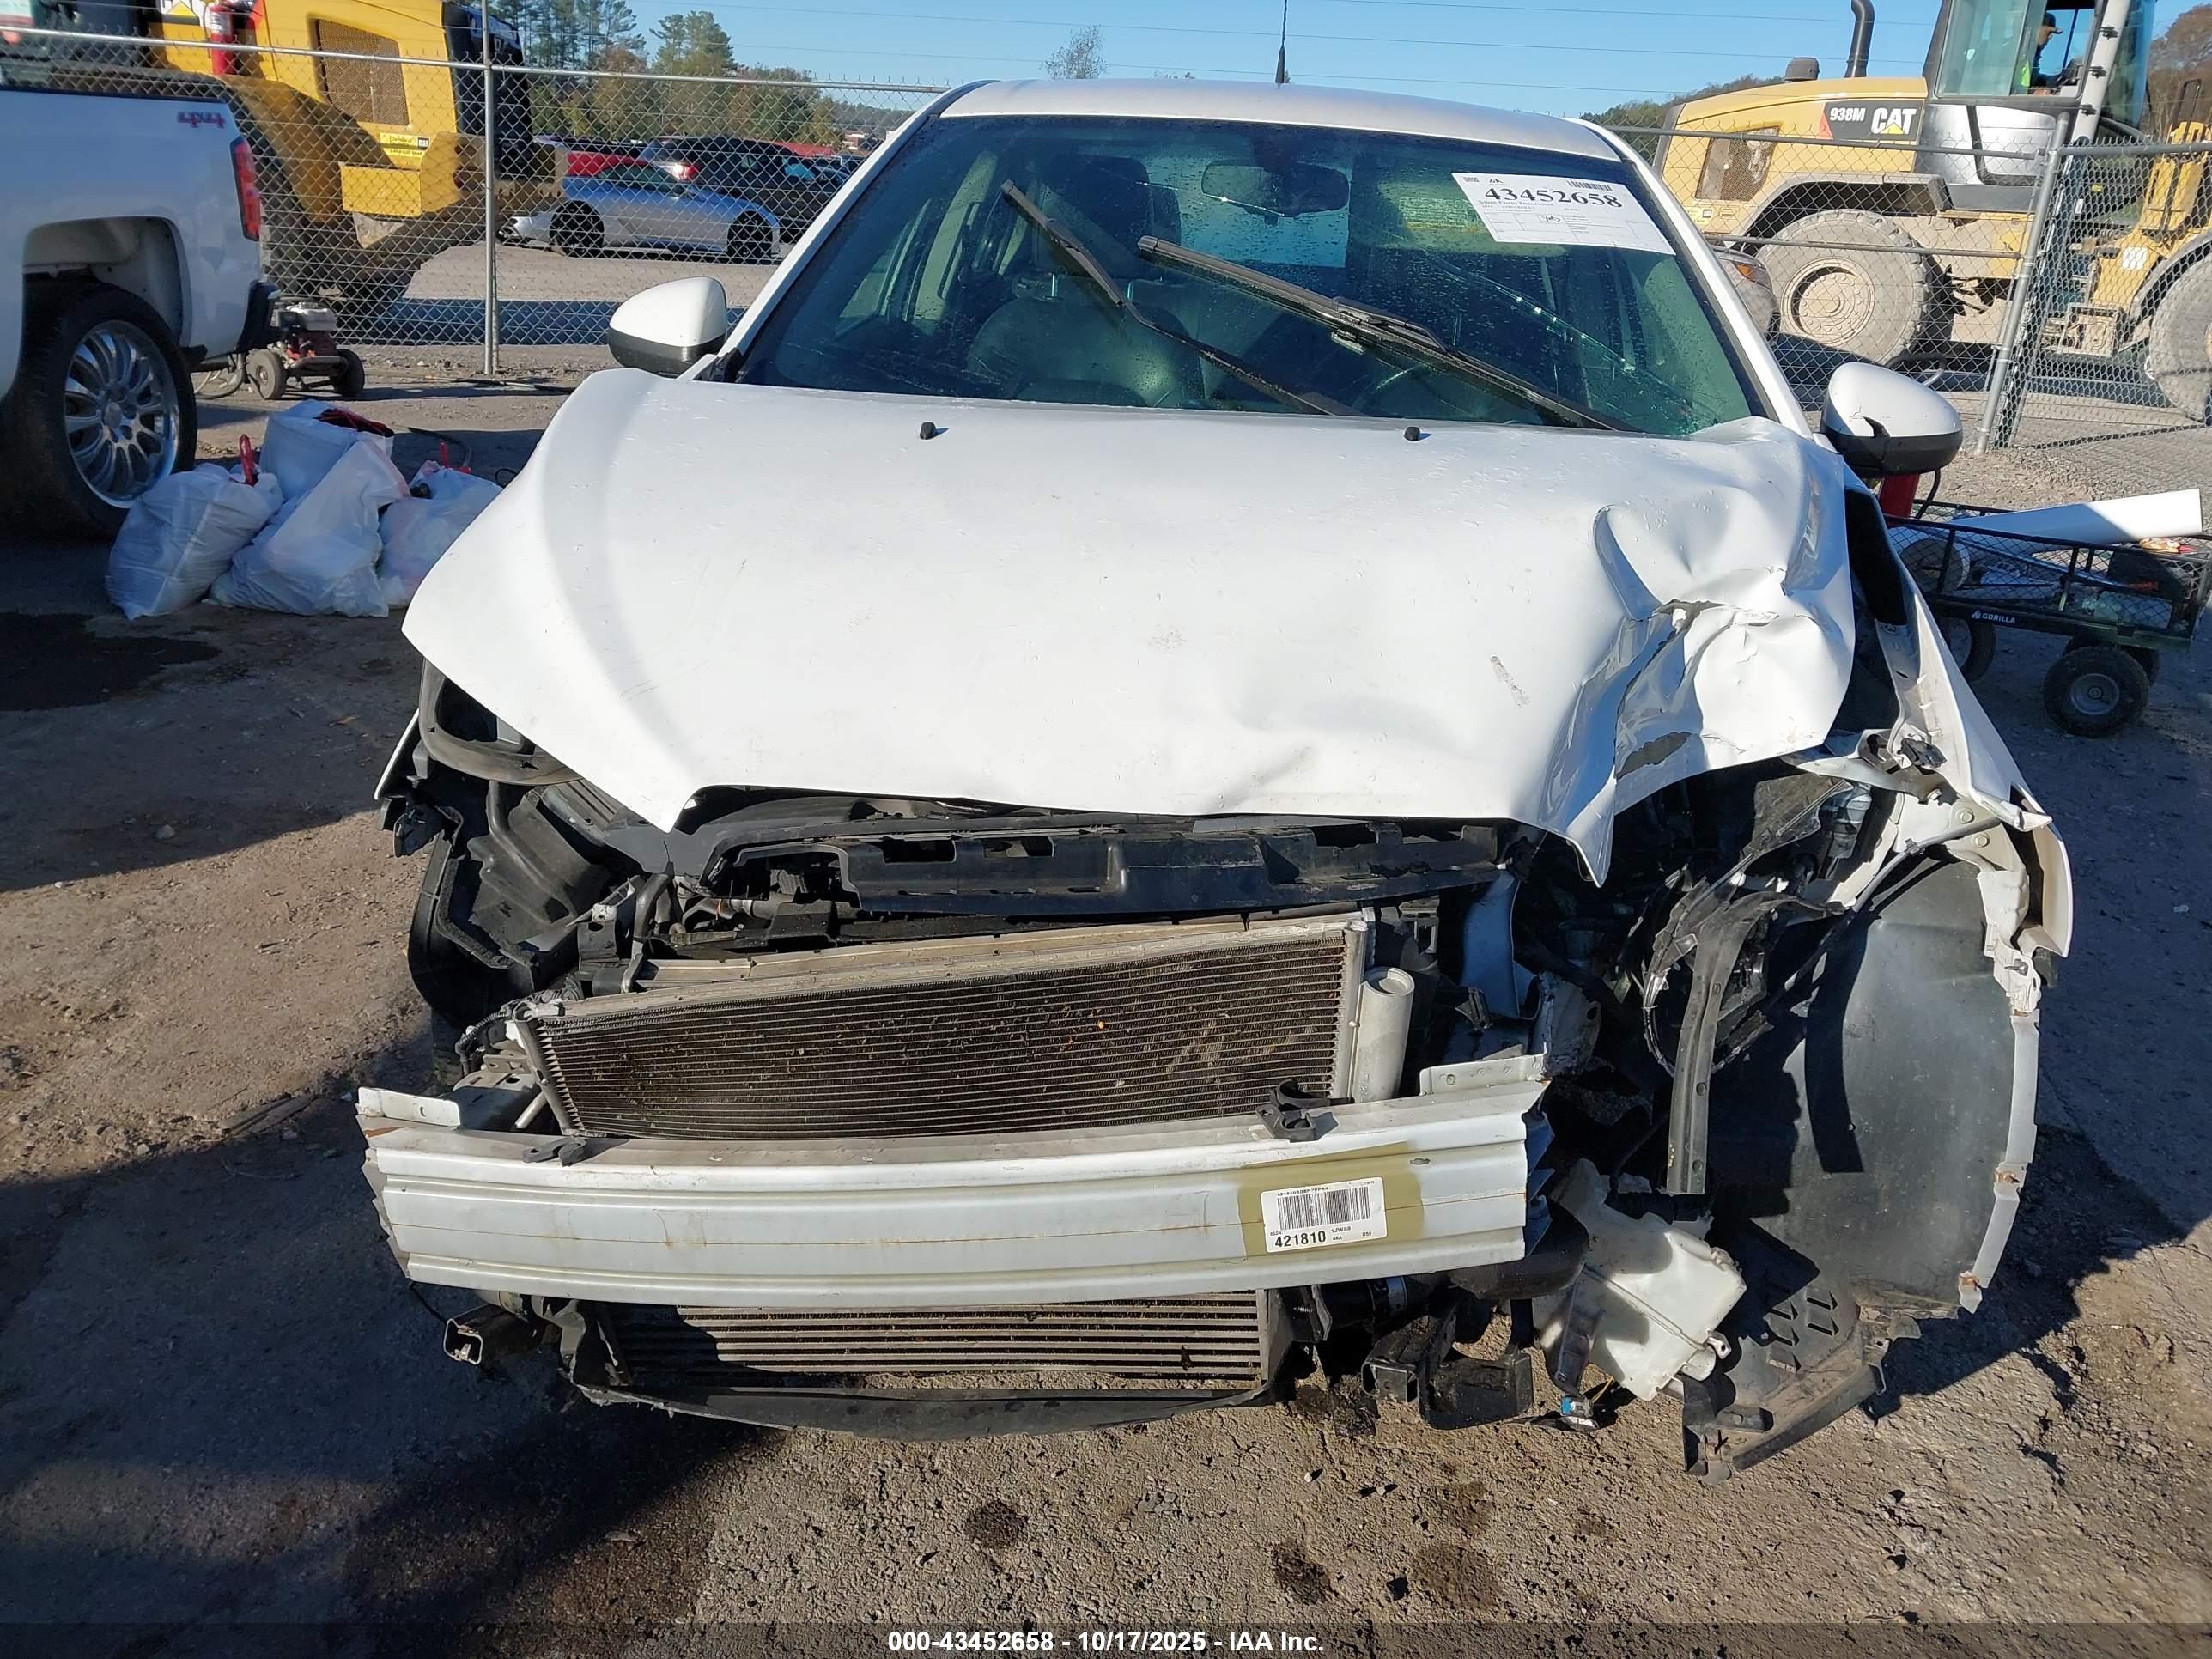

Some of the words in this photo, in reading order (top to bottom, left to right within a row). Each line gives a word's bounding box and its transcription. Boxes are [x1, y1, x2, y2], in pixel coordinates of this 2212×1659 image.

[1829, 107, 1867, 122] 938M
[1870, 107, 1917, 135] CAT
[1484, 187, 1623, 208] 43452658
[1982, 613, 2015, 623] GORILLA
[1274, 1231, 1326, 1247] 421810
